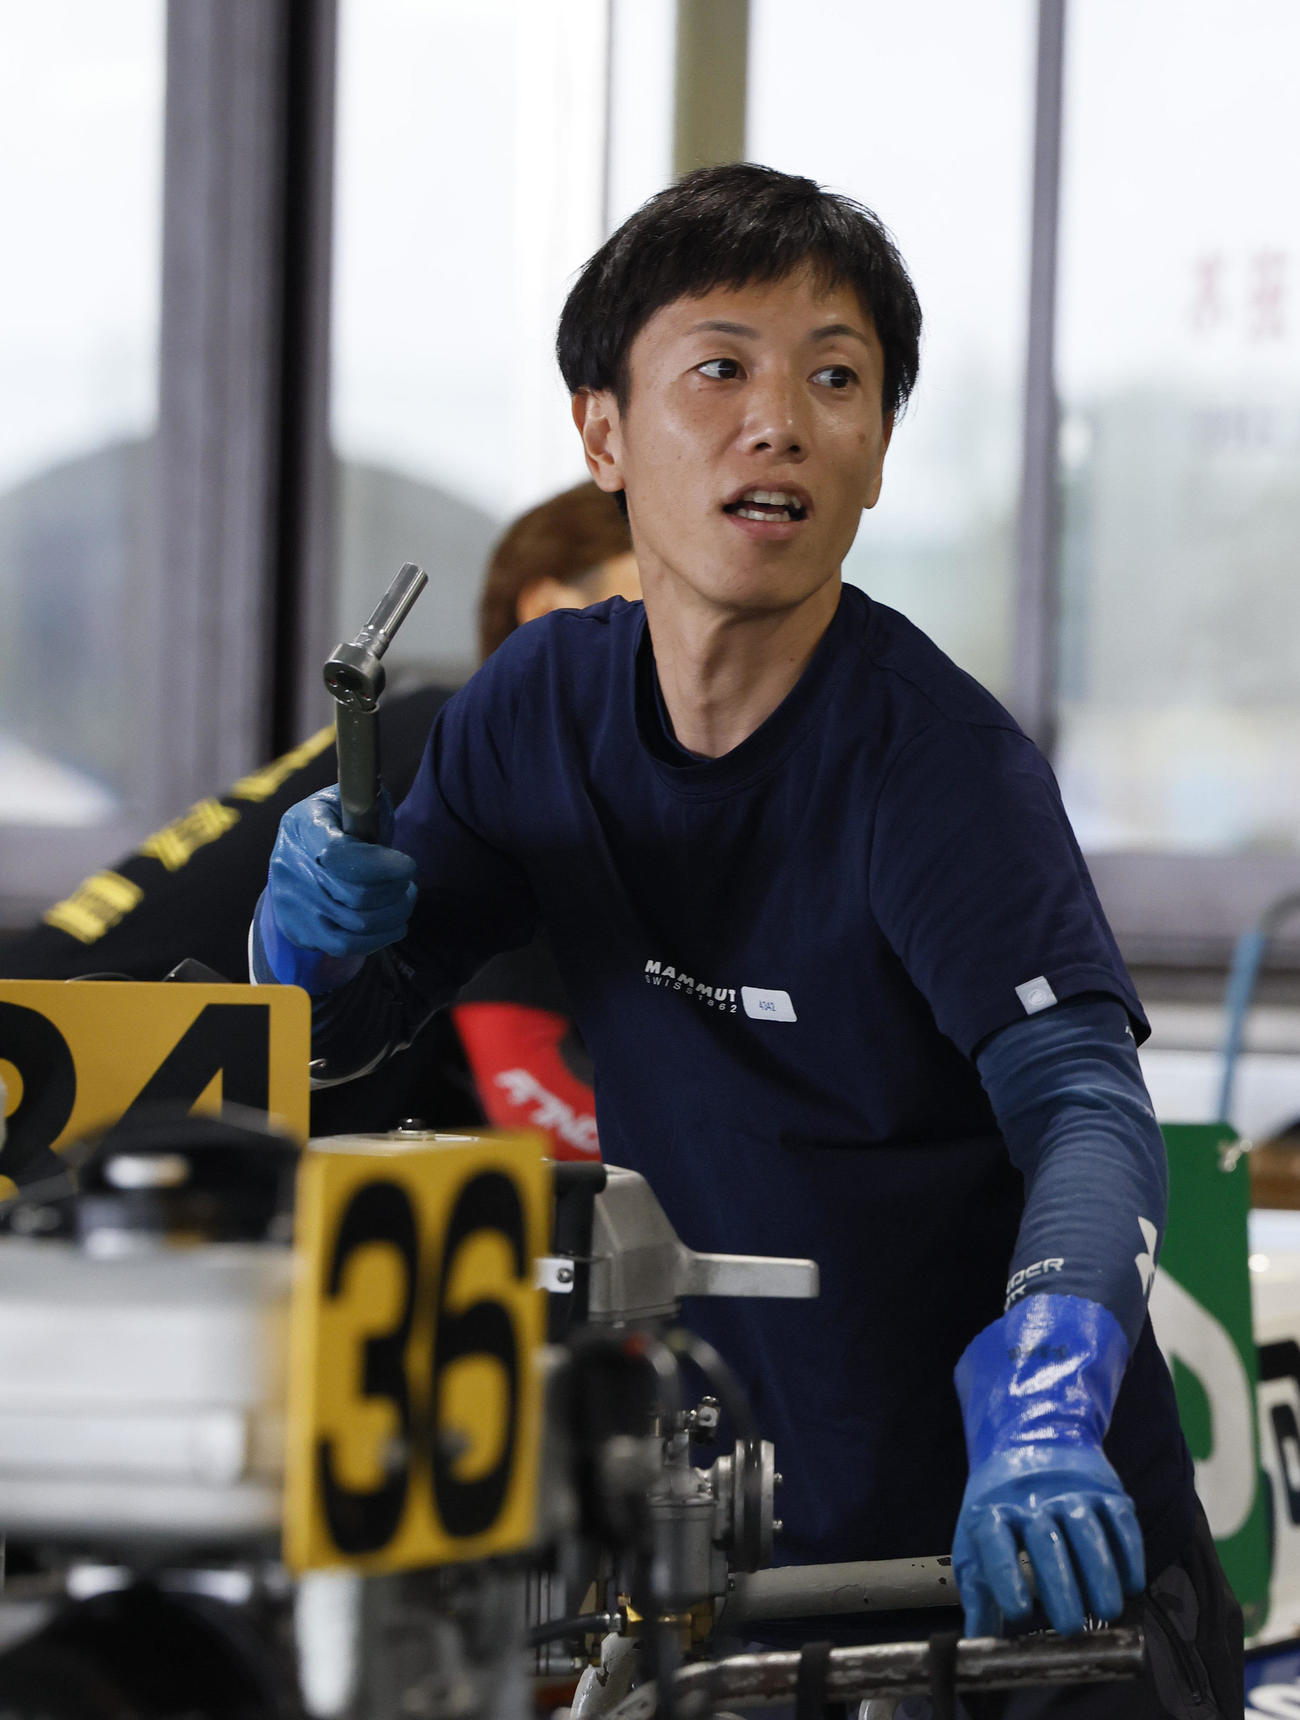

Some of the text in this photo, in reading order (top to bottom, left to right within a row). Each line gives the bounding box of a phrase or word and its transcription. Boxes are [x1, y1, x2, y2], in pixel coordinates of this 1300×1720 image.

[645, 959, 736, 1002] MAMMUT
[645, 974, 738, 1013] SWISS 1862
[317, 1169, 529, 1553] 36
